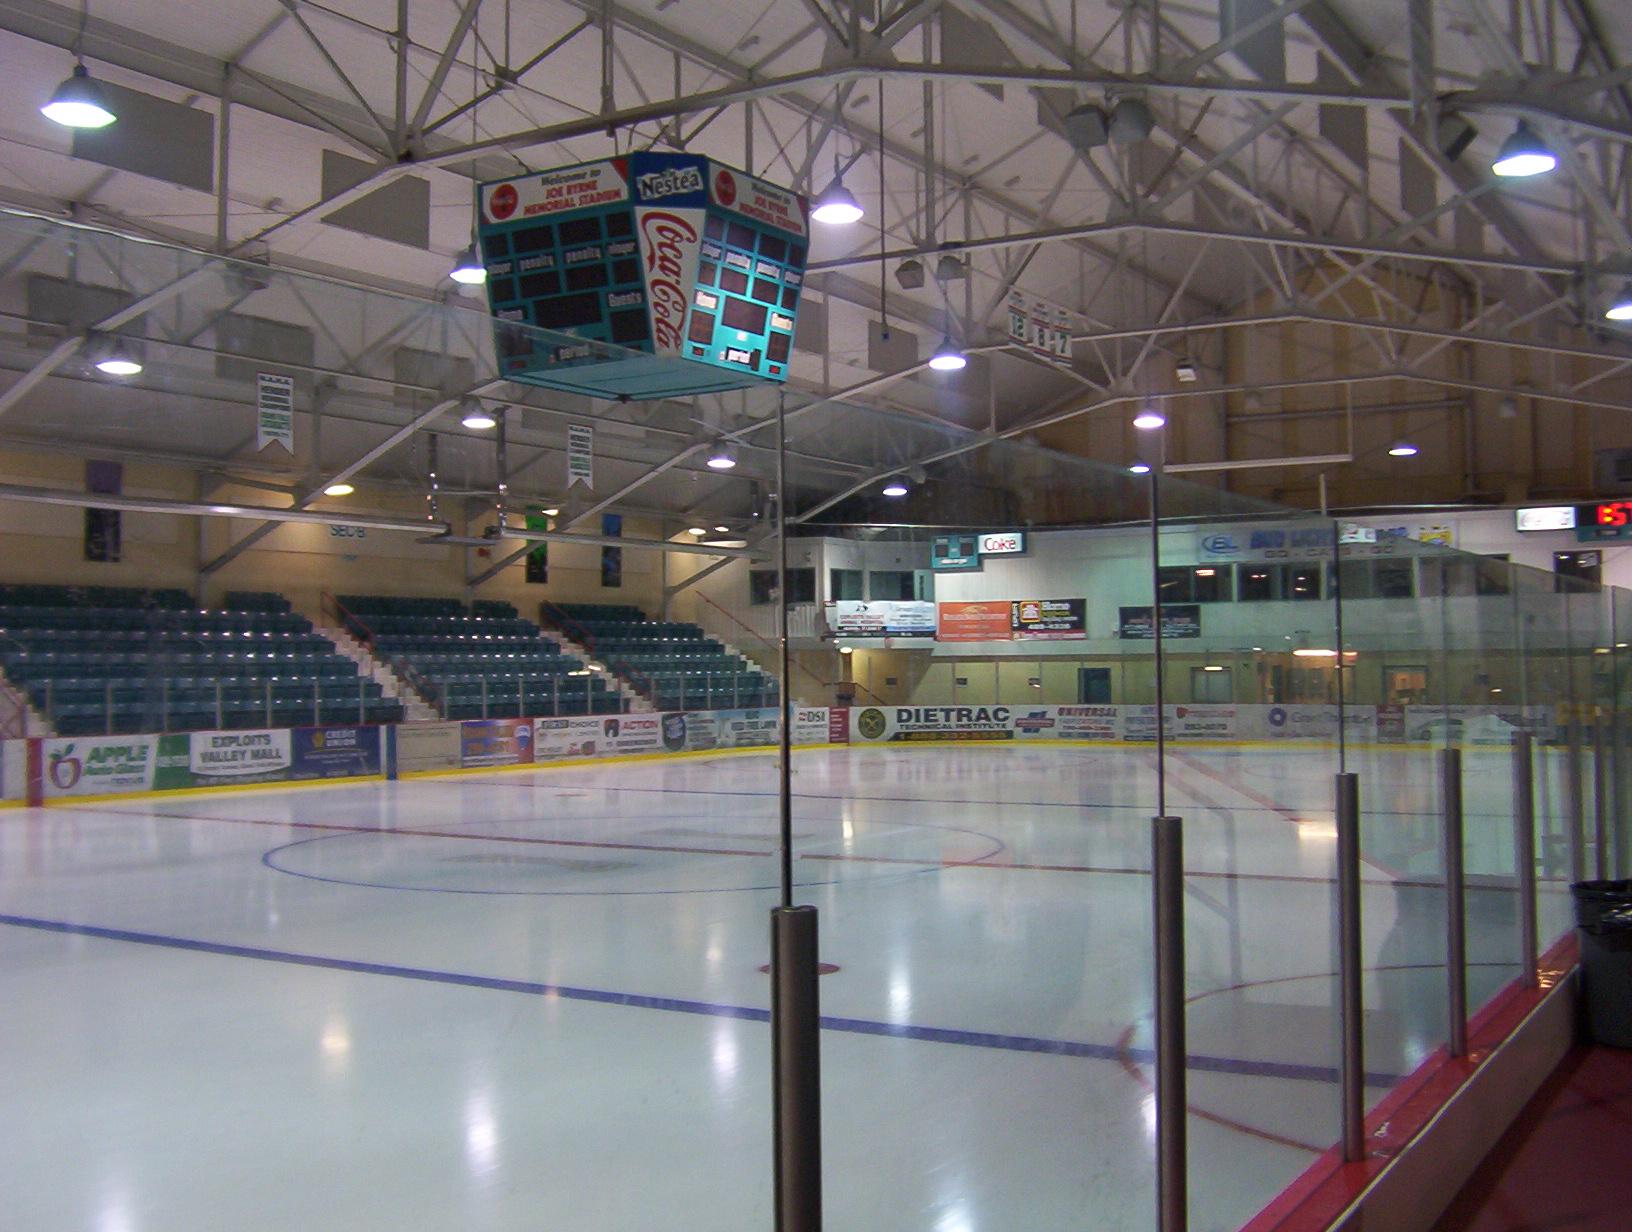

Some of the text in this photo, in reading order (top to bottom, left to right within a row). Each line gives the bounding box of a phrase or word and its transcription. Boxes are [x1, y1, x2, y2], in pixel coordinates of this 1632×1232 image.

[641, 171, 699, 199] Nestea
[984, 537, 1017, 552] Coke
[897, 707, 1010, 723] DIETRAC
[212, 734, 271, 748] EXPLOITS
[87, 745, 149, 763] APPLE
[200, 750, 247, 762] VALLEY
[250, 748, 282, 760] MALL
